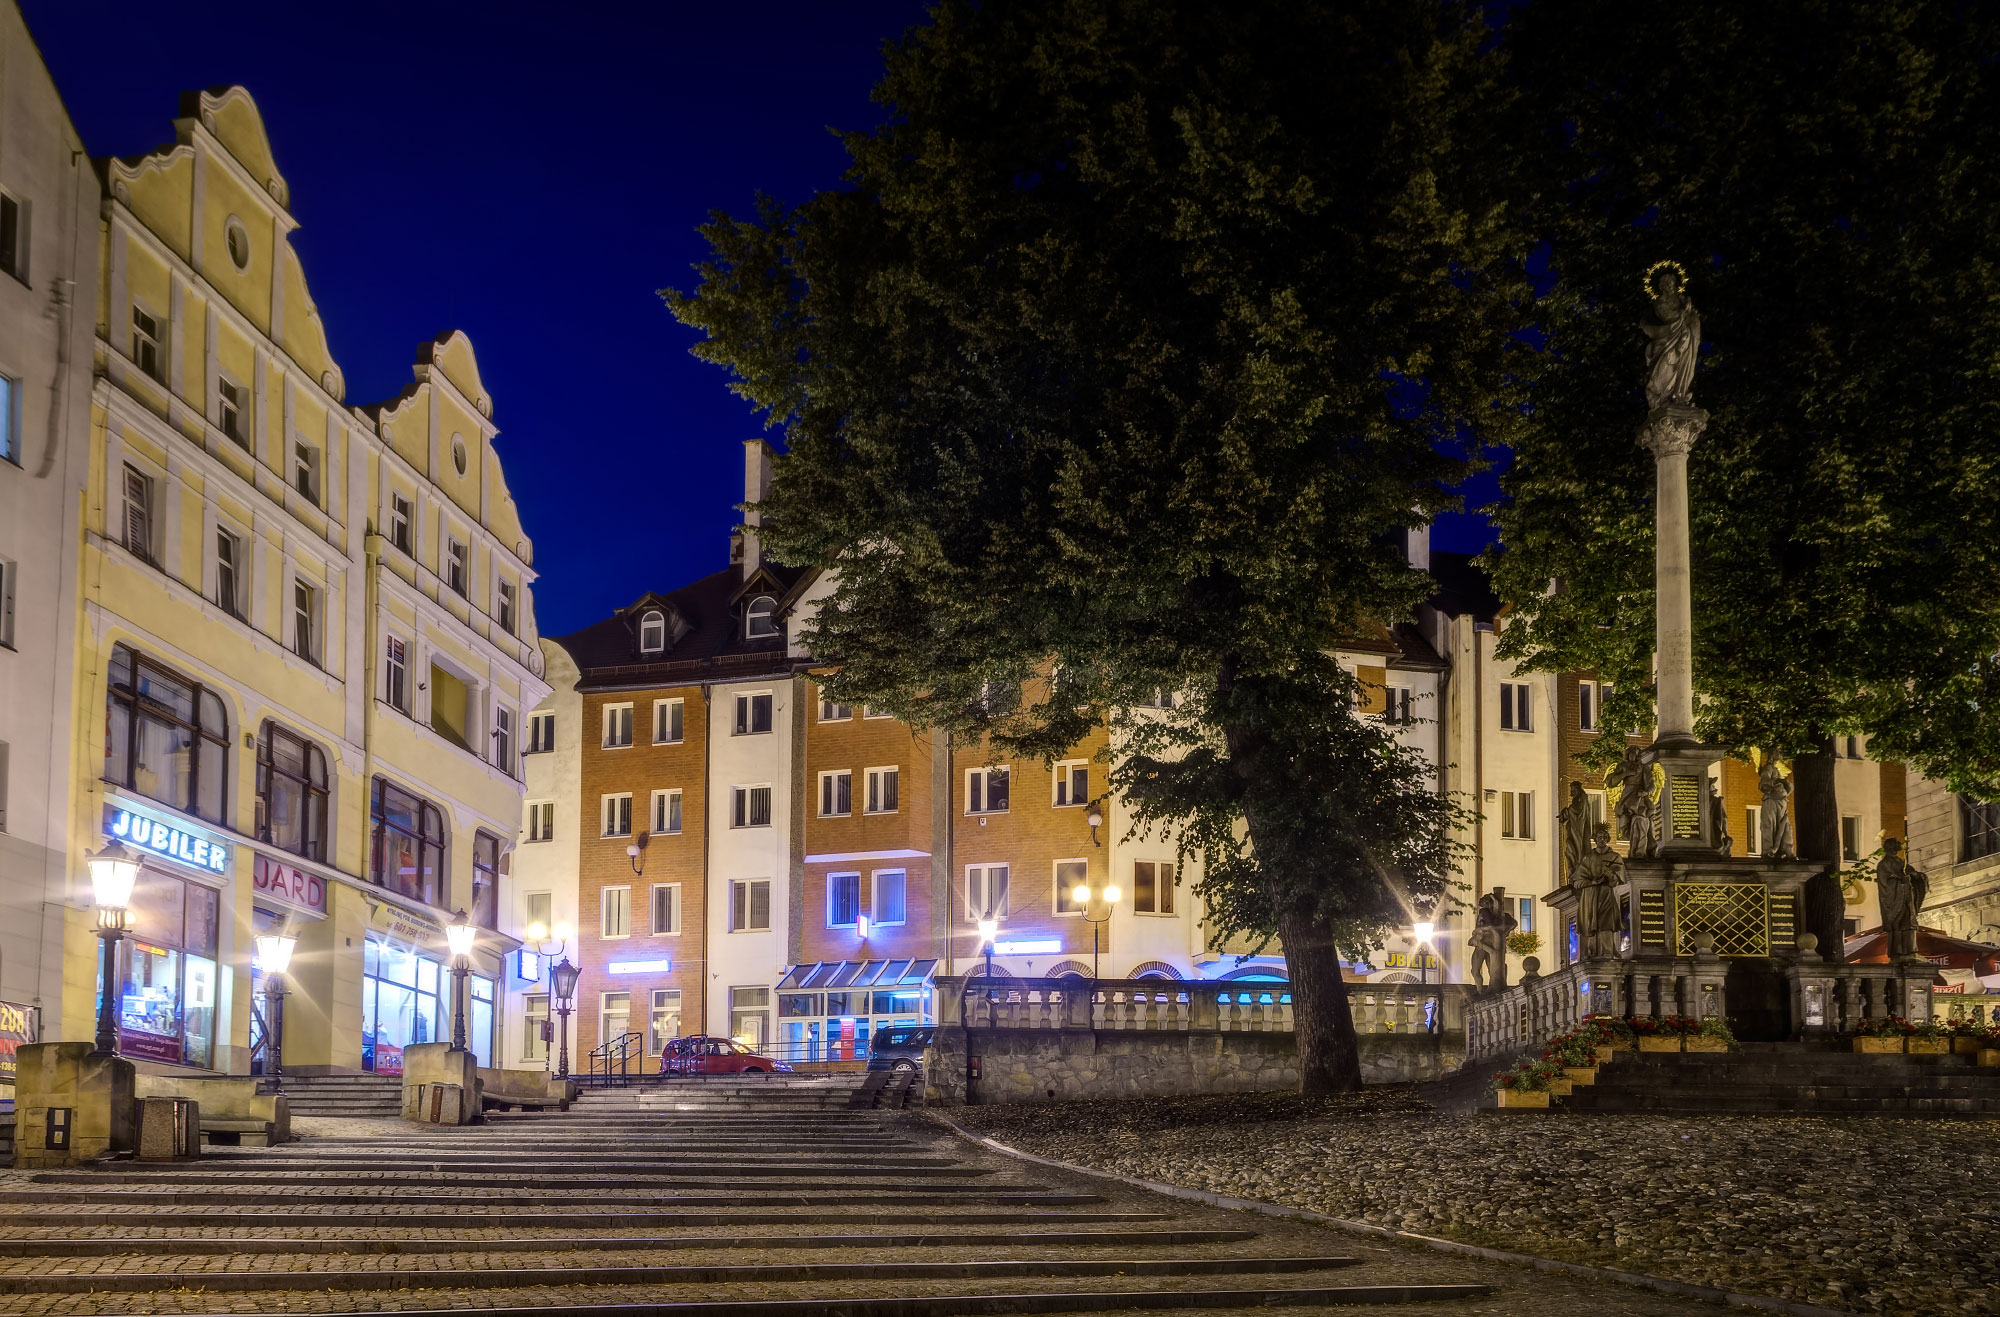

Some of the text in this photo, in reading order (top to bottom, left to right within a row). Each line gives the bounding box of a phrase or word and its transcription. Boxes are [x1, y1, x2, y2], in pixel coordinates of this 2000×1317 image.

[112, 809, 227, 872] JUBILER
[254, 859, 323, 907] JARD
[1927, 956, 1950, 967] SKIE
